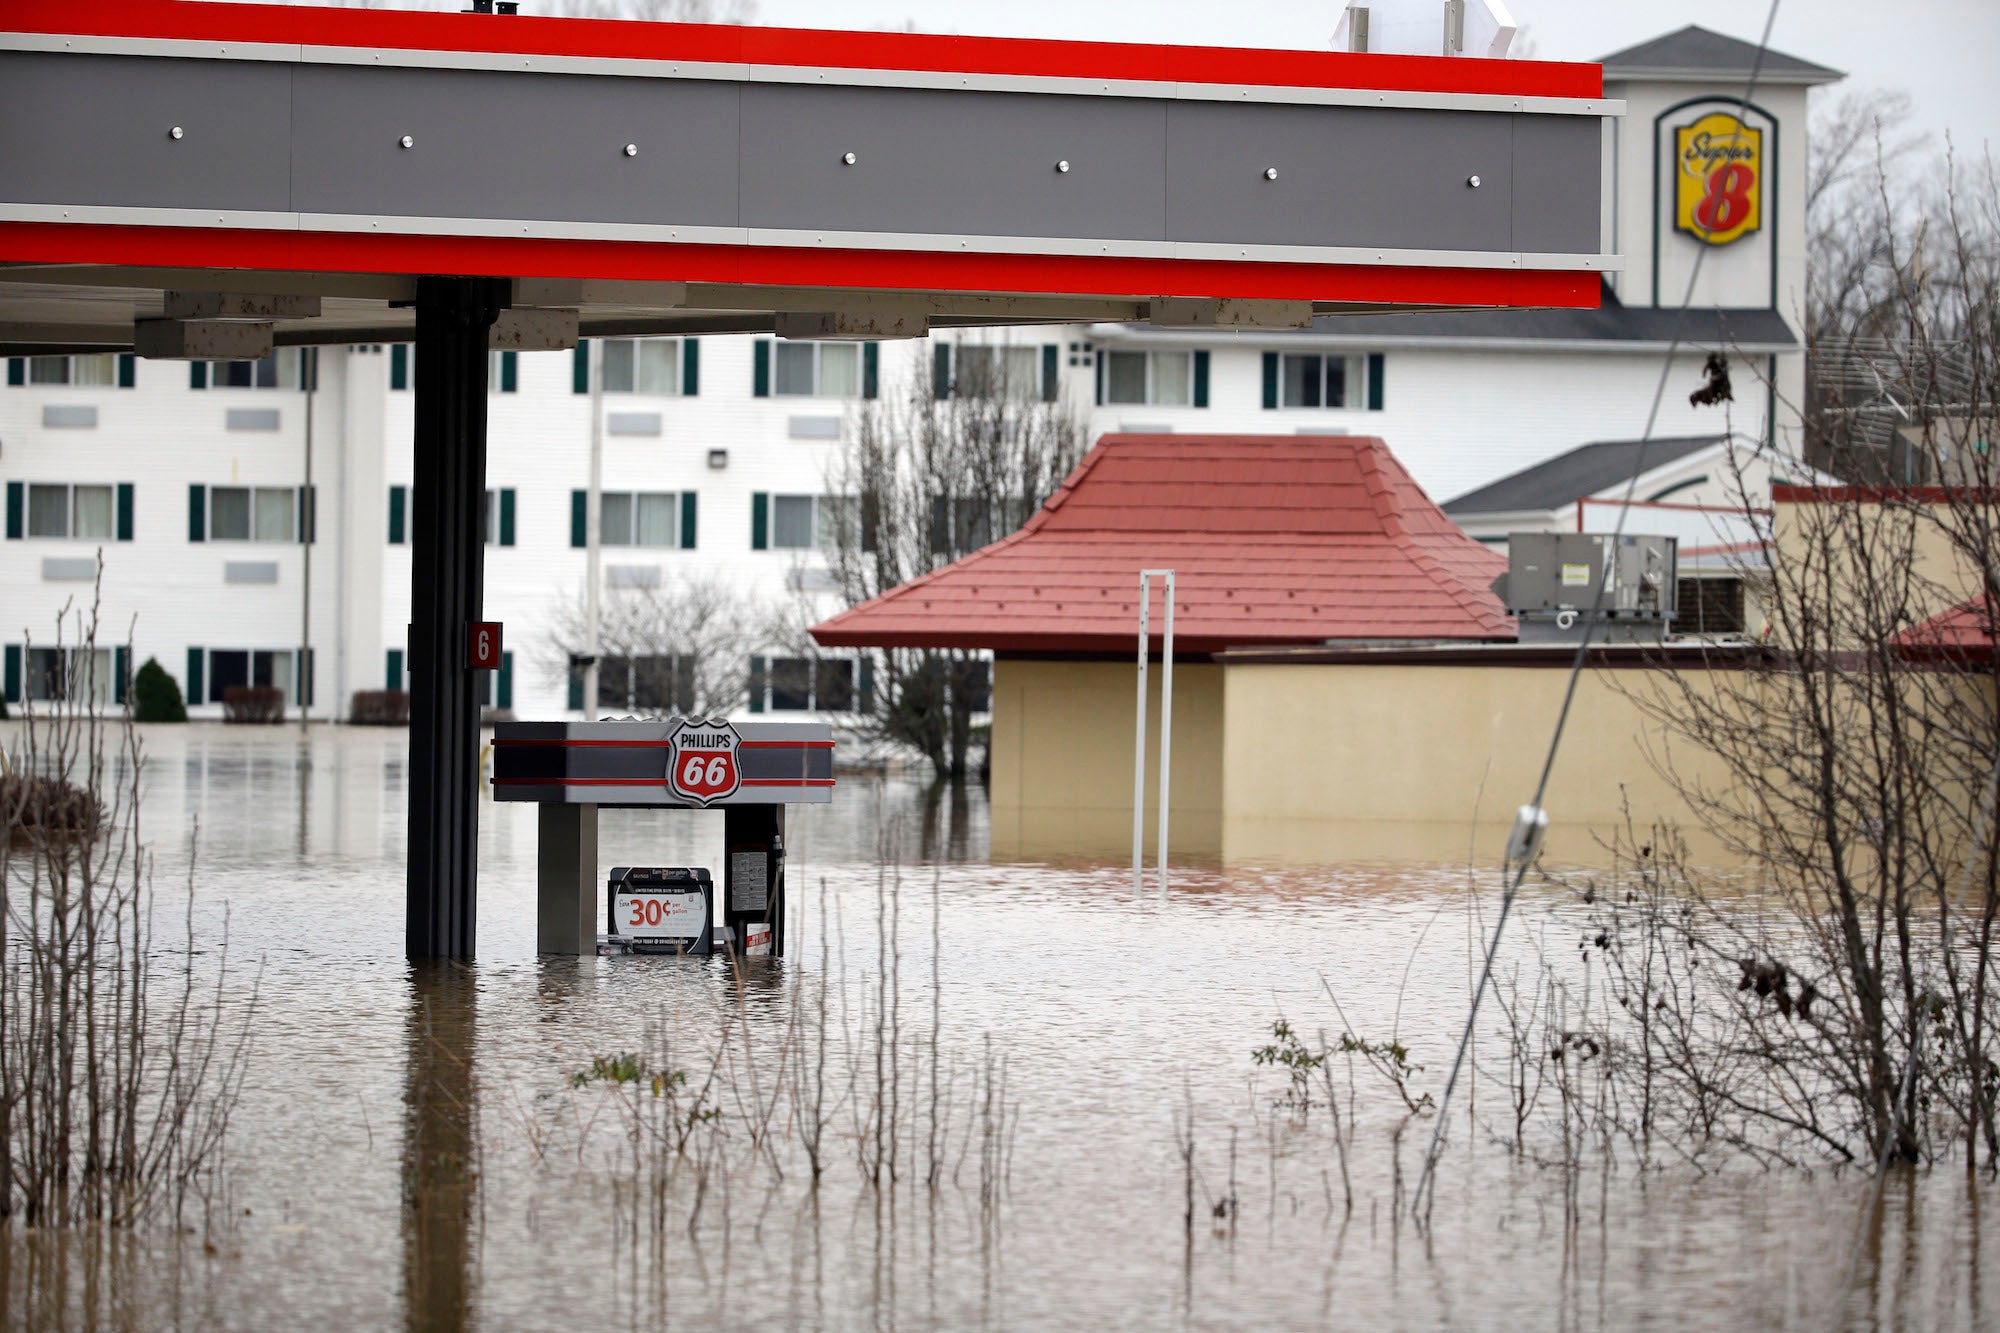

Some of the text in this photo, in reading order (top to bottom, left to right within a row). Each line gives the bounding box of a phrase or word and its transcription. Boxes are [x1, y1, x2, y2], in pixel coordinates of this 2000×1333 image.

[1684, 131, 1755, 172] Super
[1692, 162, 1755, 232] 8
[478, 630, 489, 661] 6
[681, 733, 731, 748] PHILLIPS
[683, 756, 727, 787] 66
